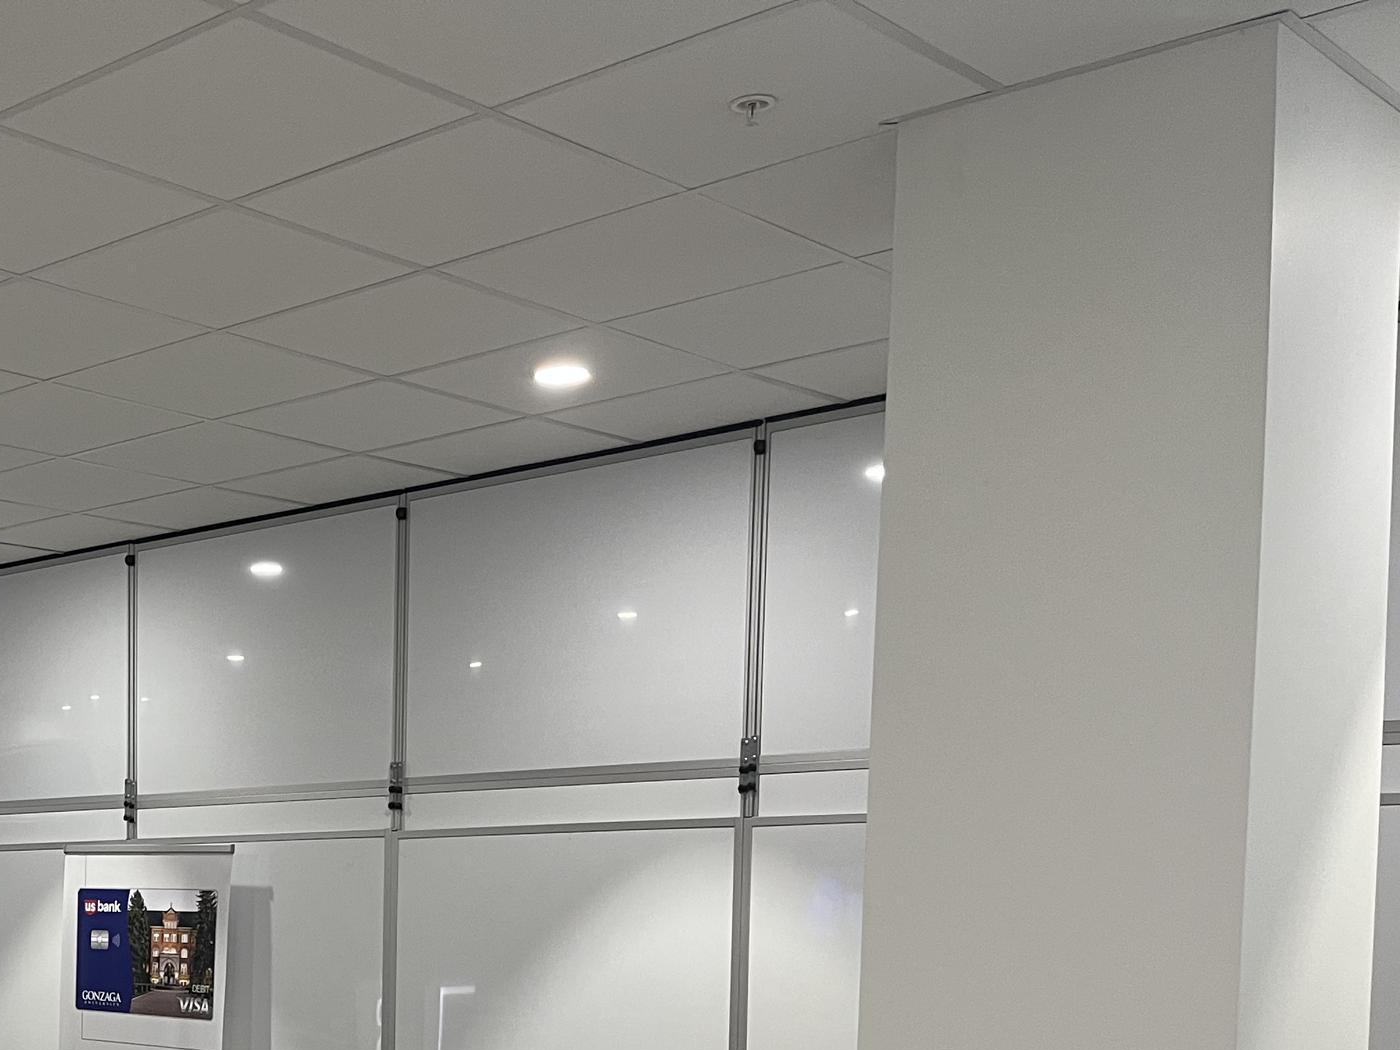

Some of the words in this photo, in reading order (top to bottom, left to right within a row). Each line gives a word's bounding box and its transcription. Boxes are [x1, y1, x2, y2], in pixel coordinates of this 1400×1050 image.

[85, 902, 96, 912] us
[97, 900, 122, 913] bank
[82, 990, 122, 1003] GONZAGA
[176, 996, 209, 1012] VISA
